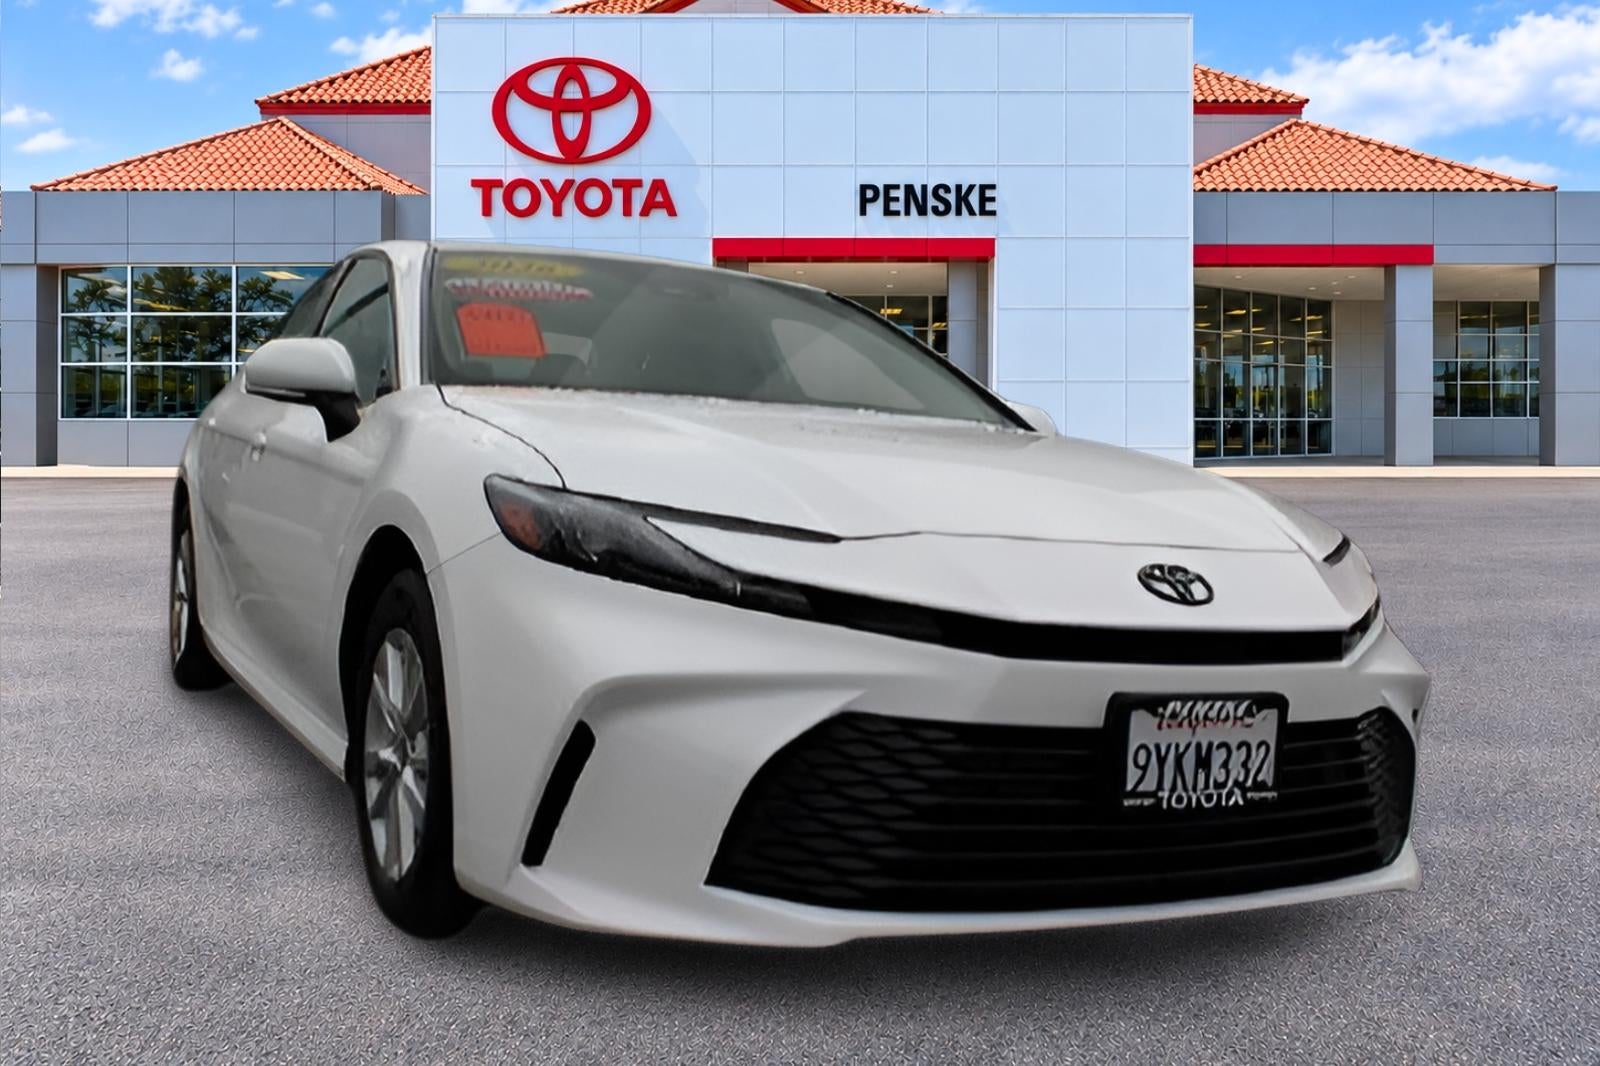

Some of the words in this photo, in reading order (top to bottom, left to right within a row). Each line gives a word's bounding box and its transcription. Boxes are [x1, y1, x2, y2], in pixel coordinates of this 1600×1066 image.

[471, 178, 677, 218] TOYOTA
[859, 183, 997, 217] PENSKE
[1132, 740, 1271, 792] 9YKM332
